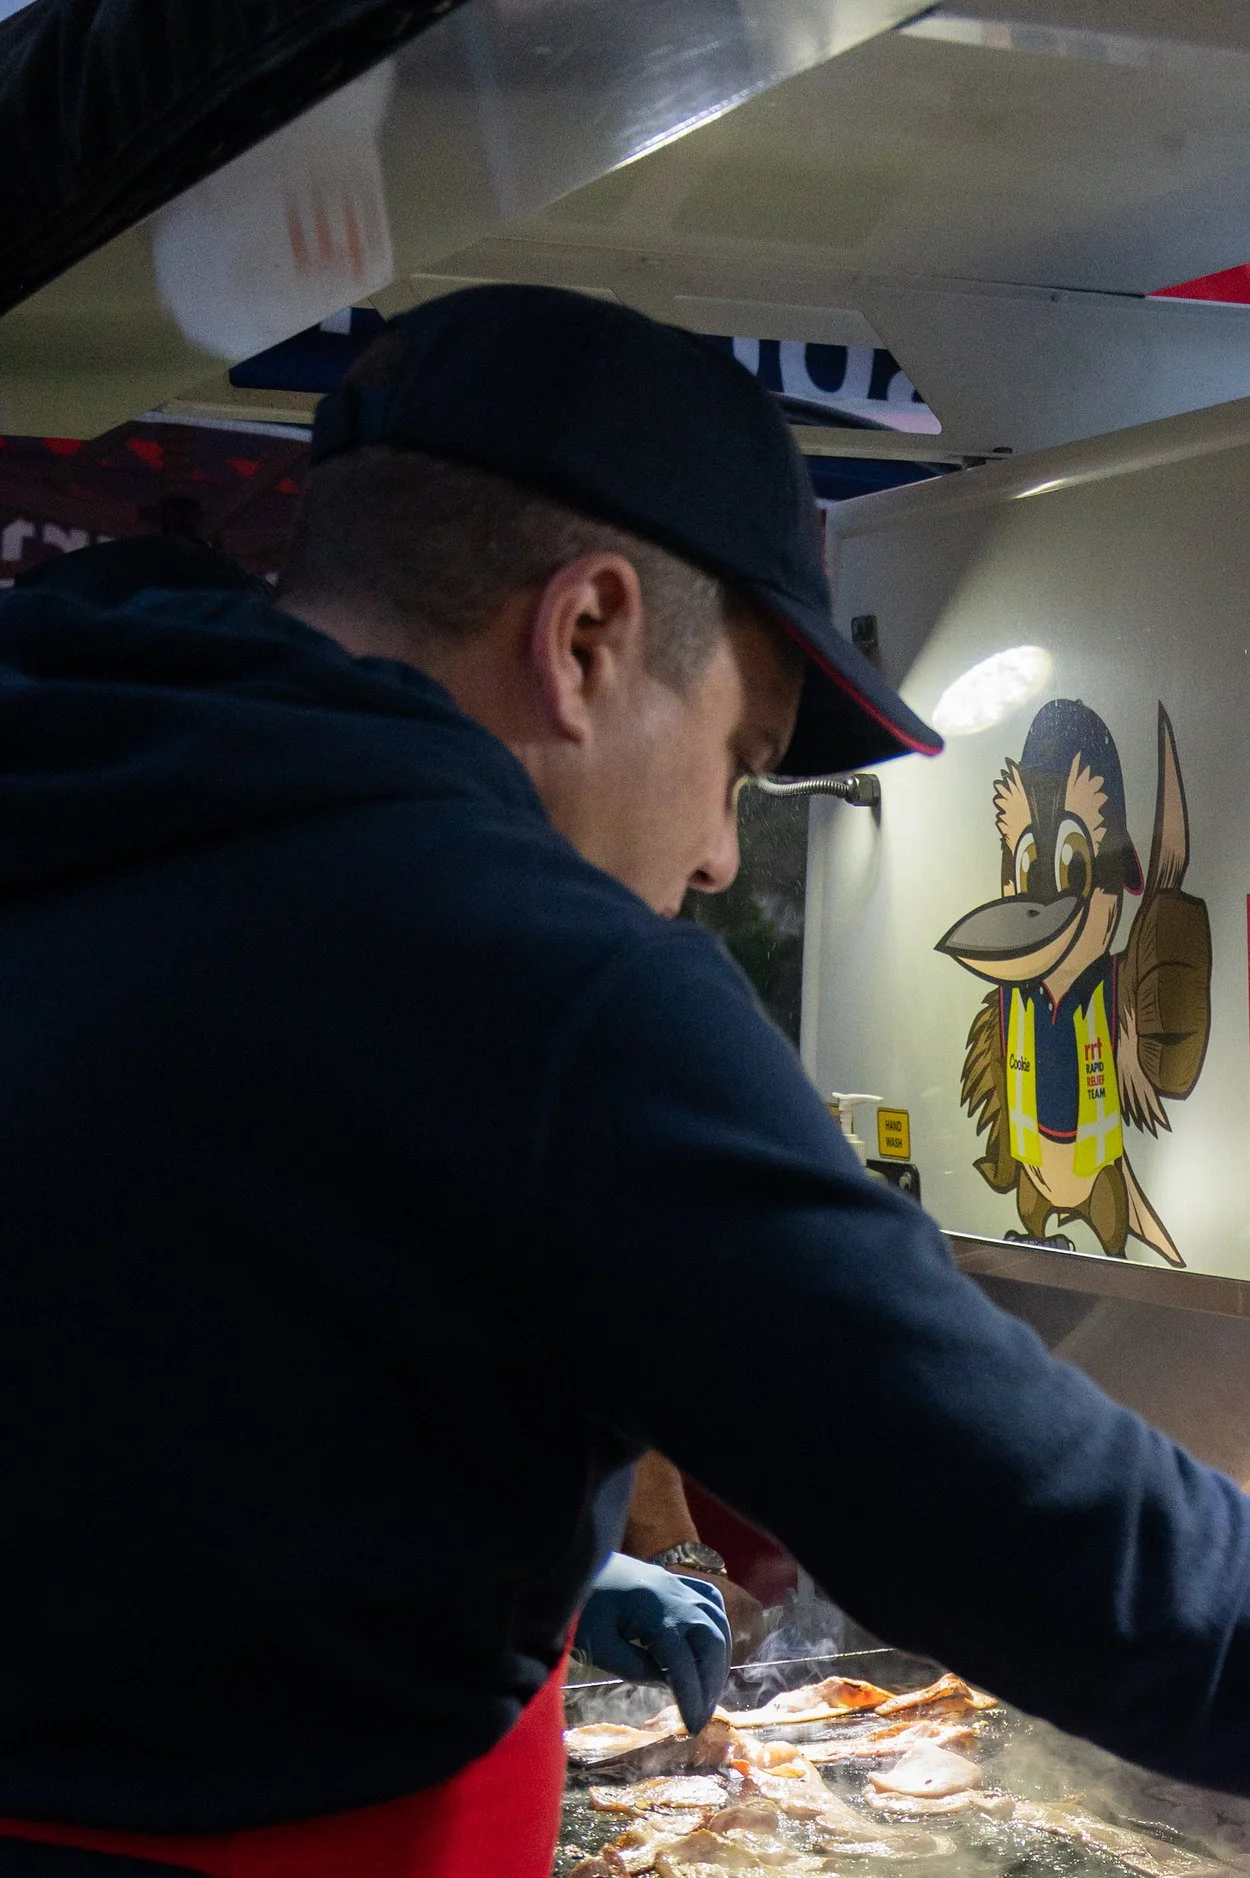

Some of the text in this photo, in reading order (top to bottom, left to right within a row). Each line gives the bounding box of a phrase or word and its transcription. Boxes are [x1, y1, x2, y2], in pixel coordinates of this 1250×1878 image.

[1085, 1036, 1103, 1061] rrt
[1009, 1053, 1031, 1072] Cookie
[1085, 1061, 1105, 1074] RAPID
[1086, 1075, 1105, 1087] RELIEF
[1087, 1088, 1107, 1100] TEAM
[884, 1120, 903, 1132] HAND
[885, 1136, 903, 1149] WASH
